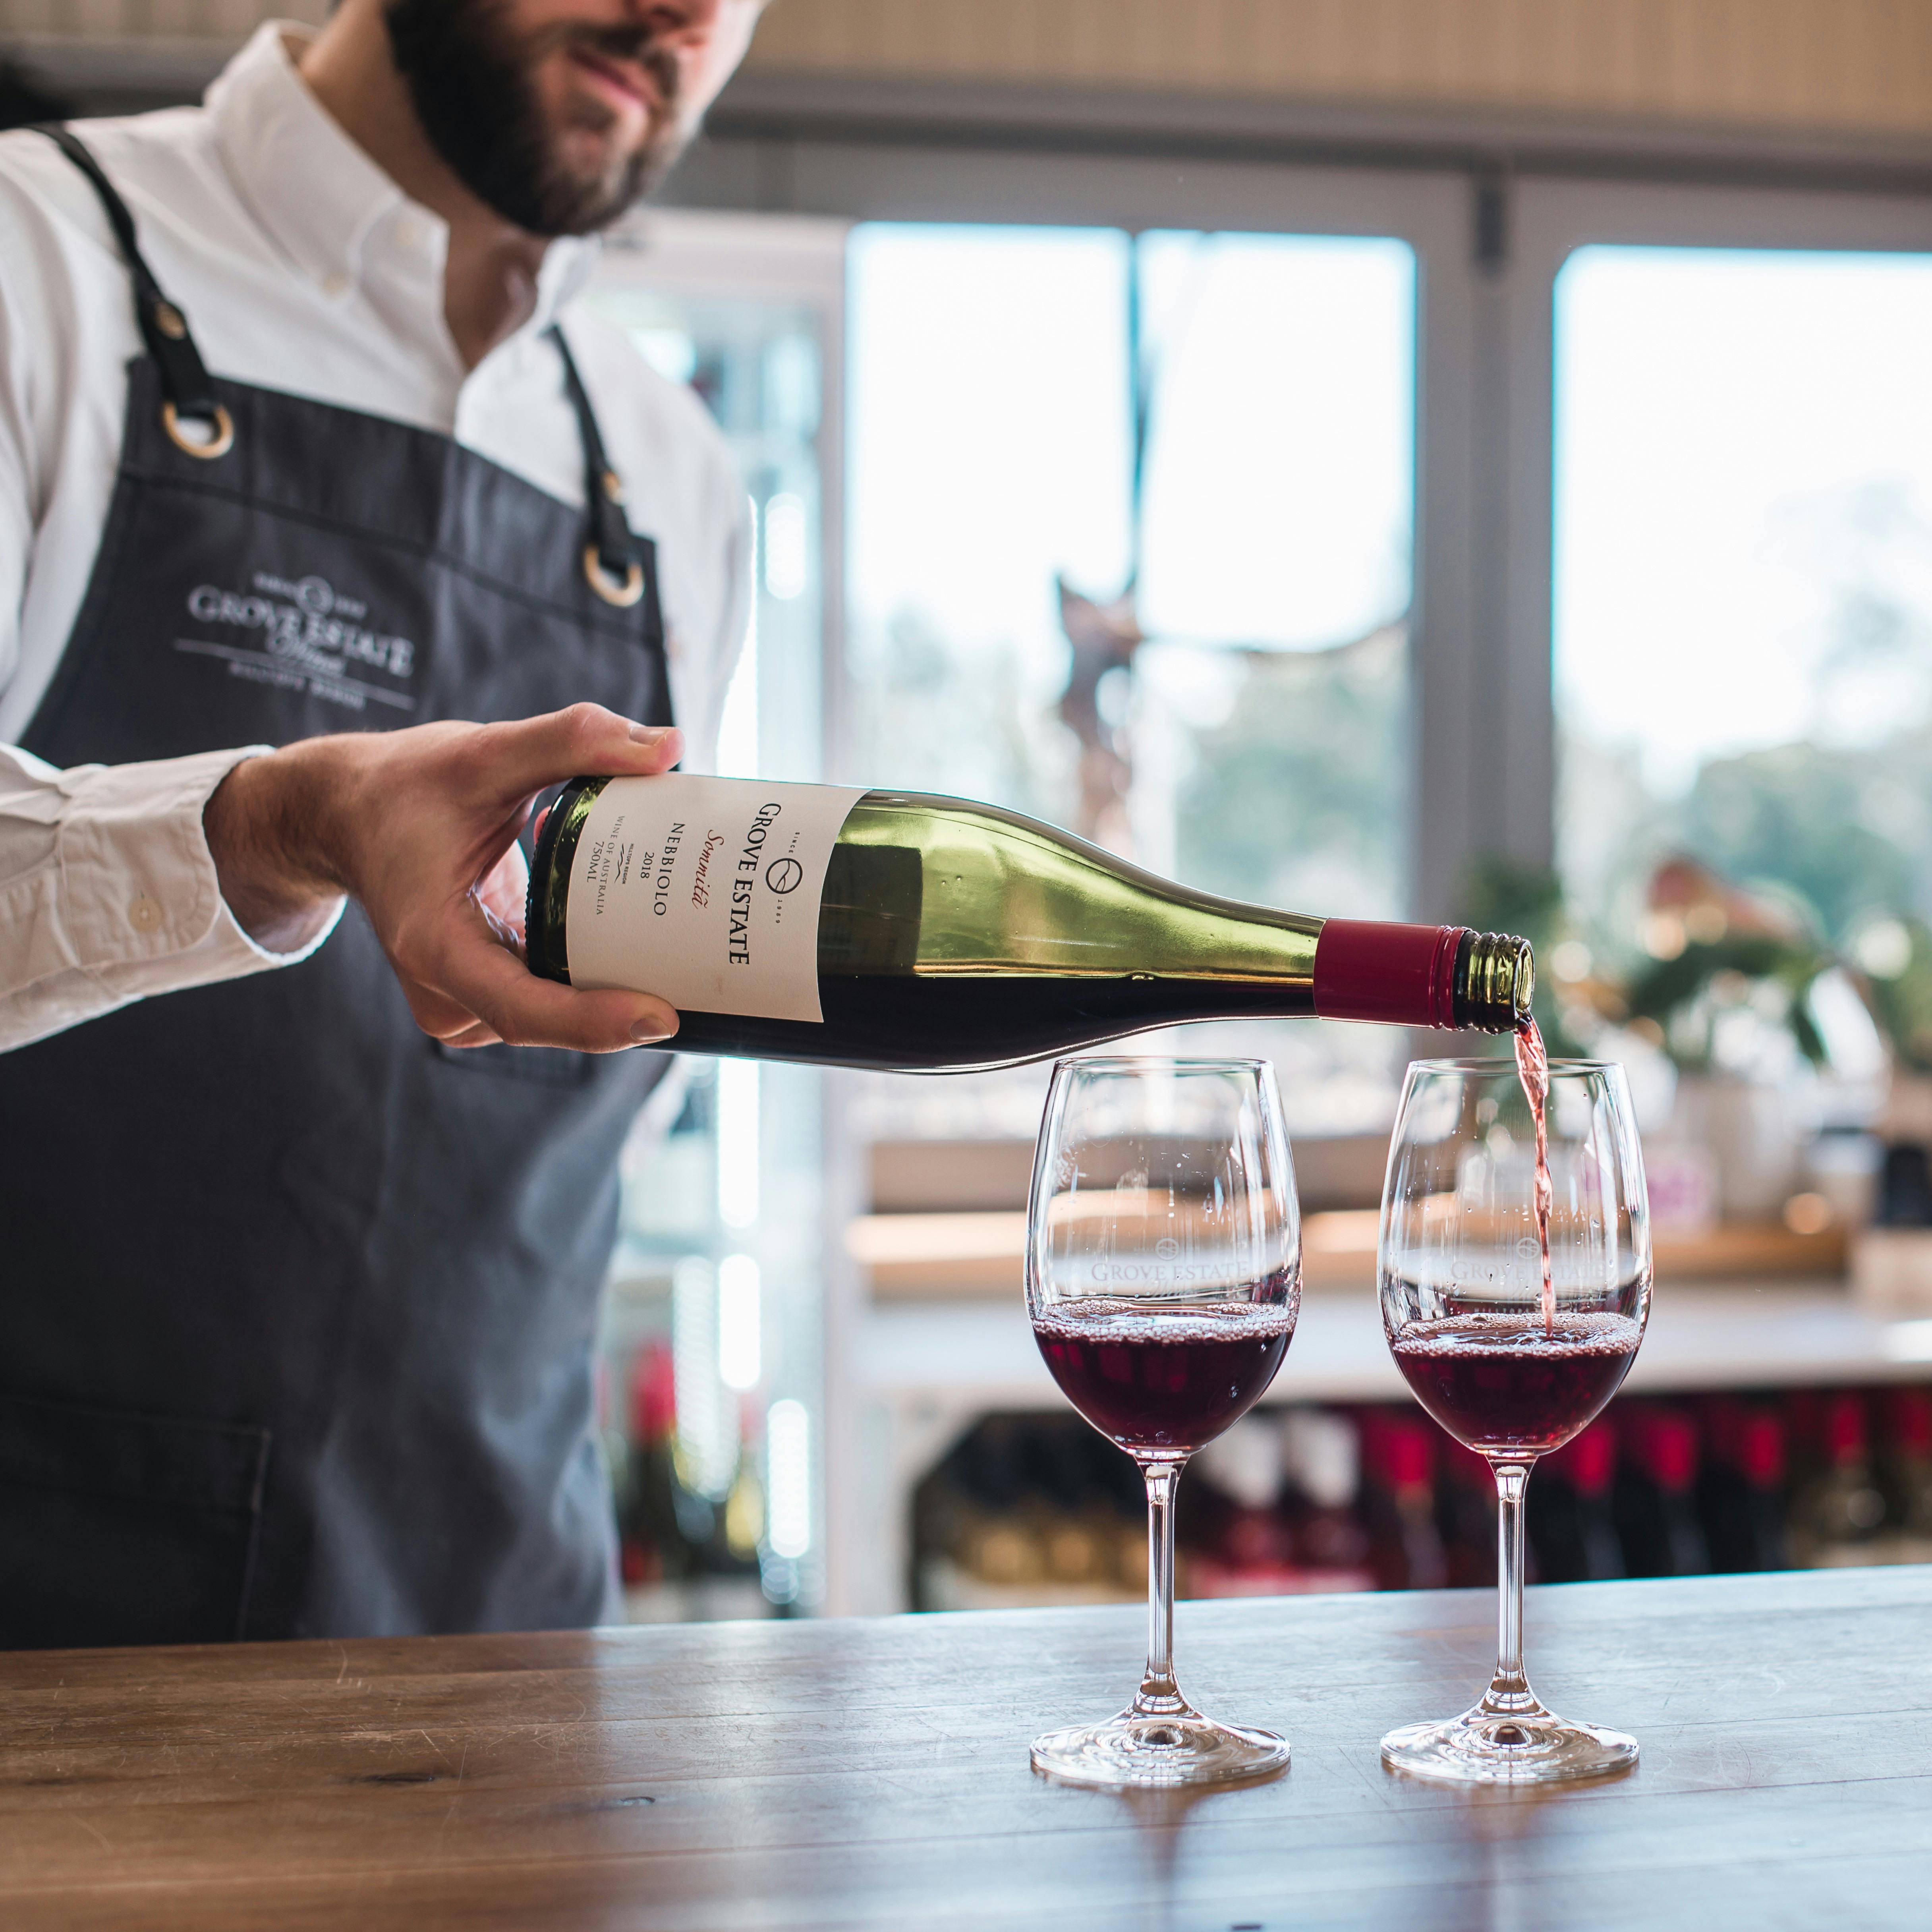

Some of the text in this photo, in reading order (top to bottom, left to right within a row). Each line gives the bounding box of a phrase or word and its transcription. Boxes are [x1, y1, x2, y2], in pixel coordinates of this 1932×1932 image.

[625, 843, 635, 866] HILLTOPS
[788, 832, 800, 854] SINCE
[587, 840, 605, 883] 750ML
[596, 815, 626, 916] WINE OF AUSTRALIA
[640, 851, 655, 879] 2018
[653, 822, 686, 916] NEBBIOLO
[728, 802, 782, 966] GROVE ESTATE
[1091, 1261, 1249, 1281] GROVE ESTATE
